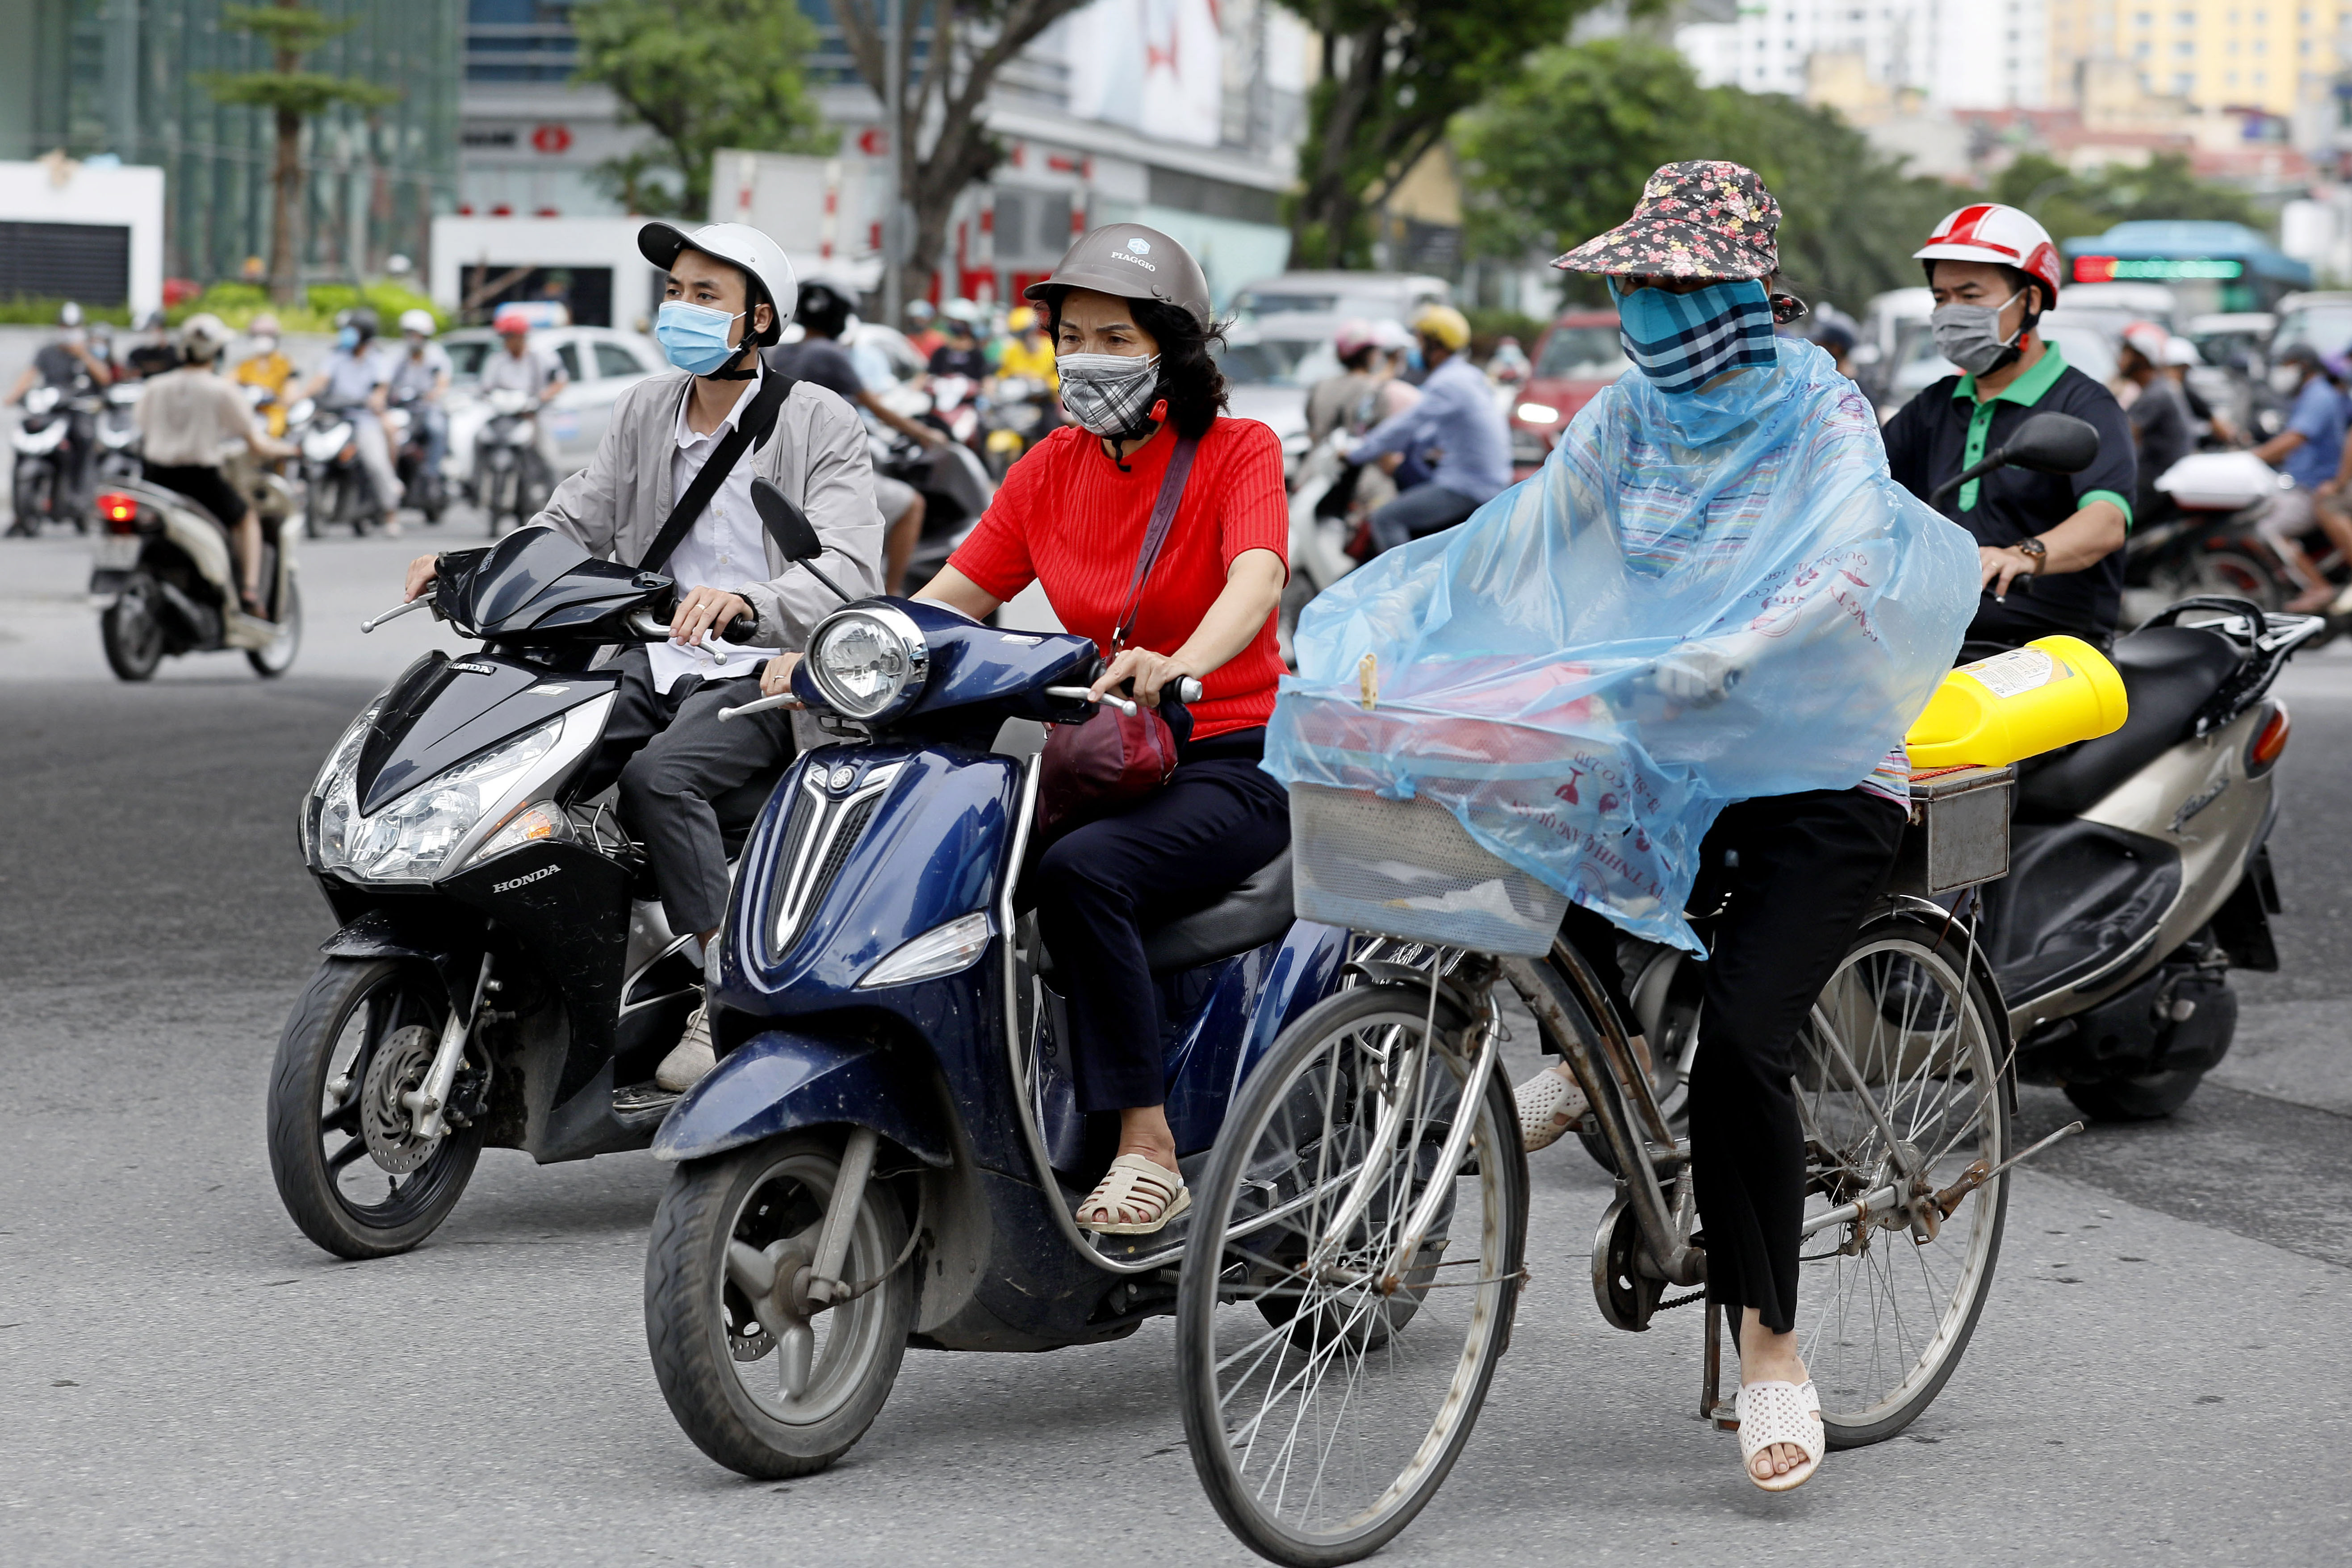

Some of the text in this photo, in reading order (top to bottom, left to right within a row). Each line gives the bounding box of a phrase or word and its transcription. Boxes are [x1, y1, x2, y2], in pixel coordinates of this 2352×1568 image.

[1111, 251, 1155, 272] PIAGGIO
[493, 864, 561, 893] HONDA
[1594, 845, 1645, 886] TNHH
